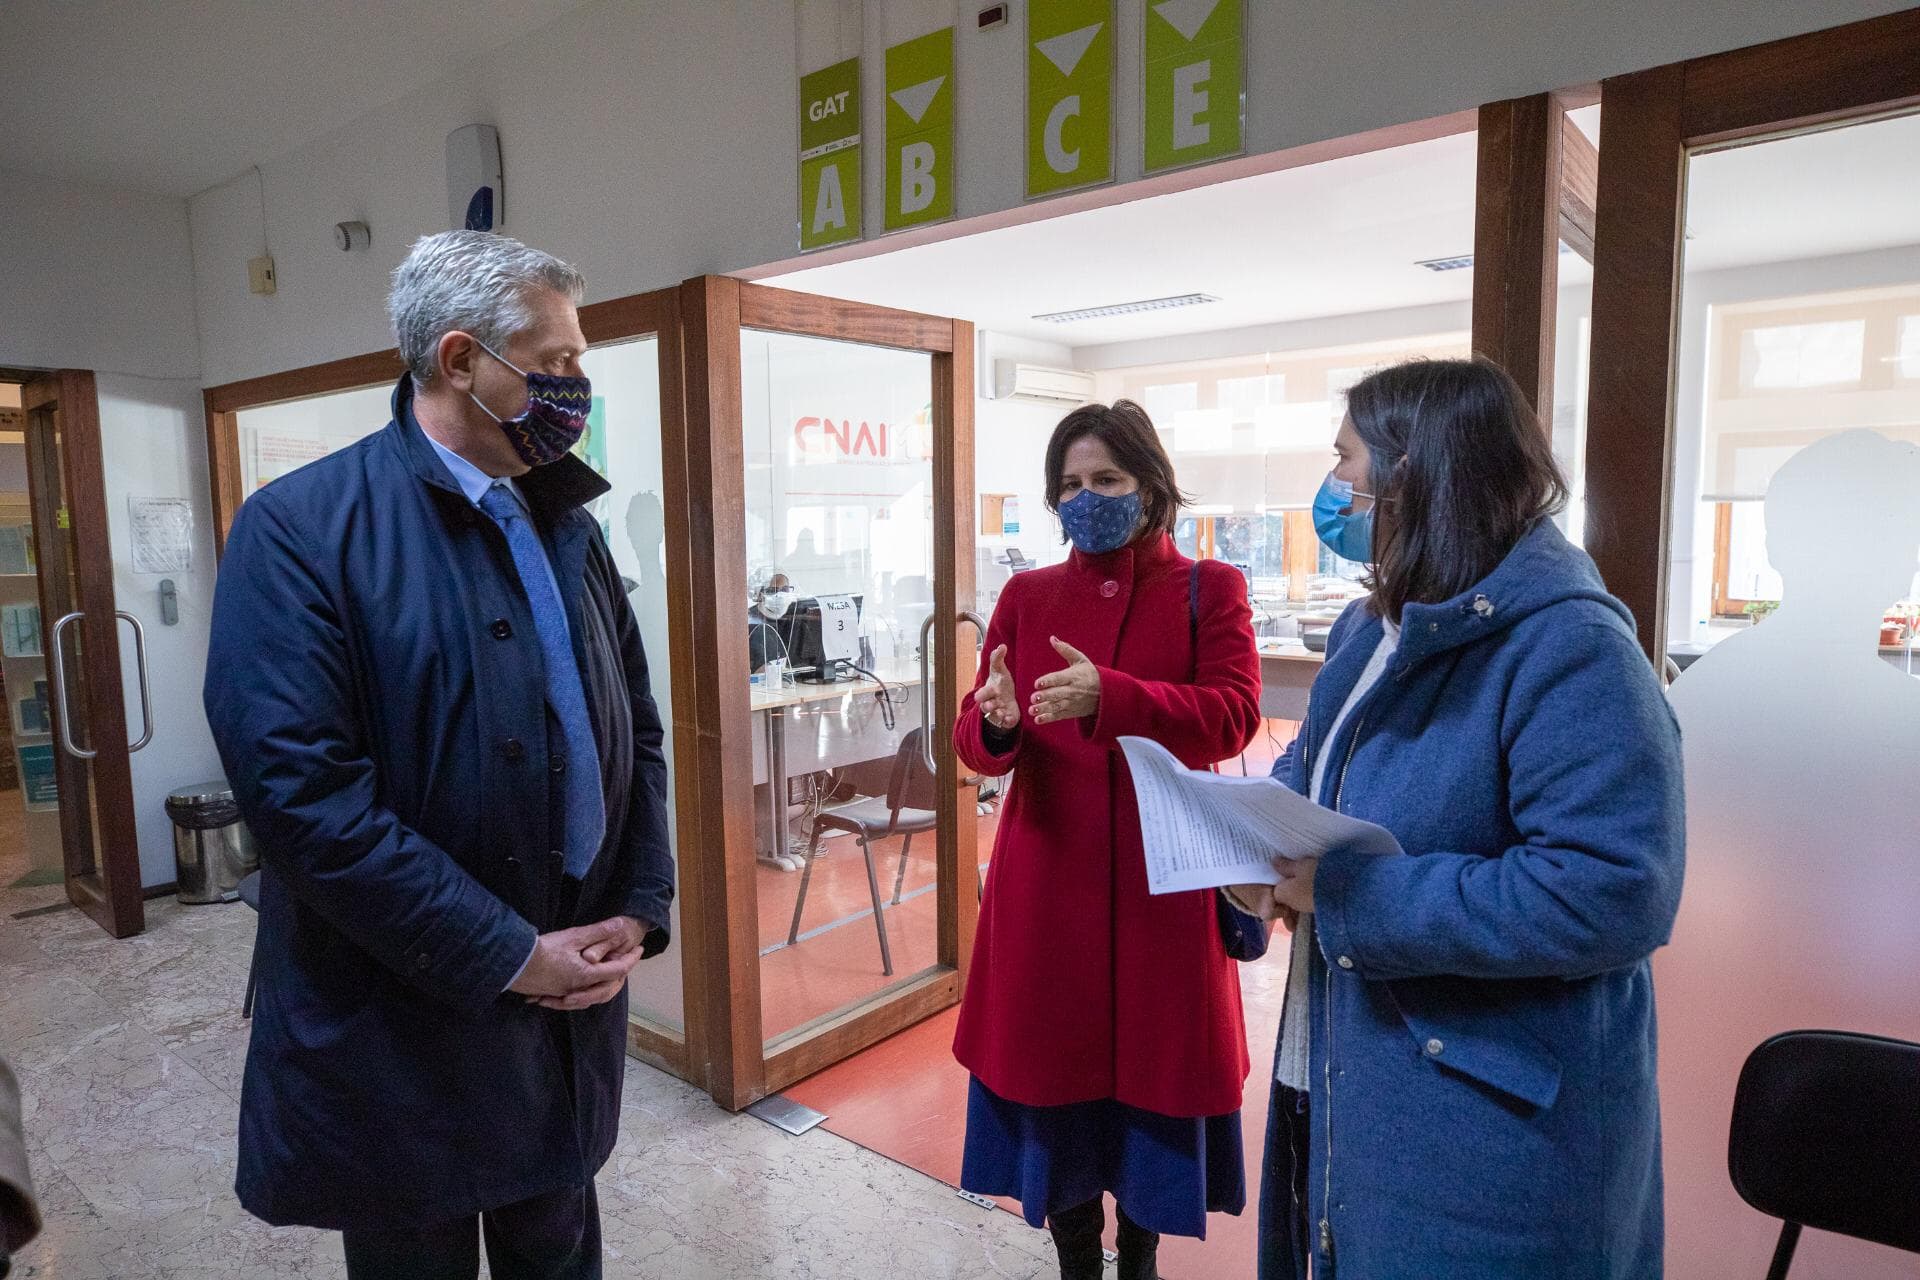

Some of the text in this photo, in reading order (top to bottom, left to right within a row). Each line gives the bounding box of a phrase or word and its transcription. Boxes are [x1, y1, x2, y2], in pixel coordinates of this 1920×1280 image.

[809, 91, 849, 122] GAT
[1043, 95, 1080, 173] C
[1173, 60, 1210, 150] E
[813, 164, 845, 234] A
[902, 141, 936, 215] B
[837, 619, 844, 631] 3
